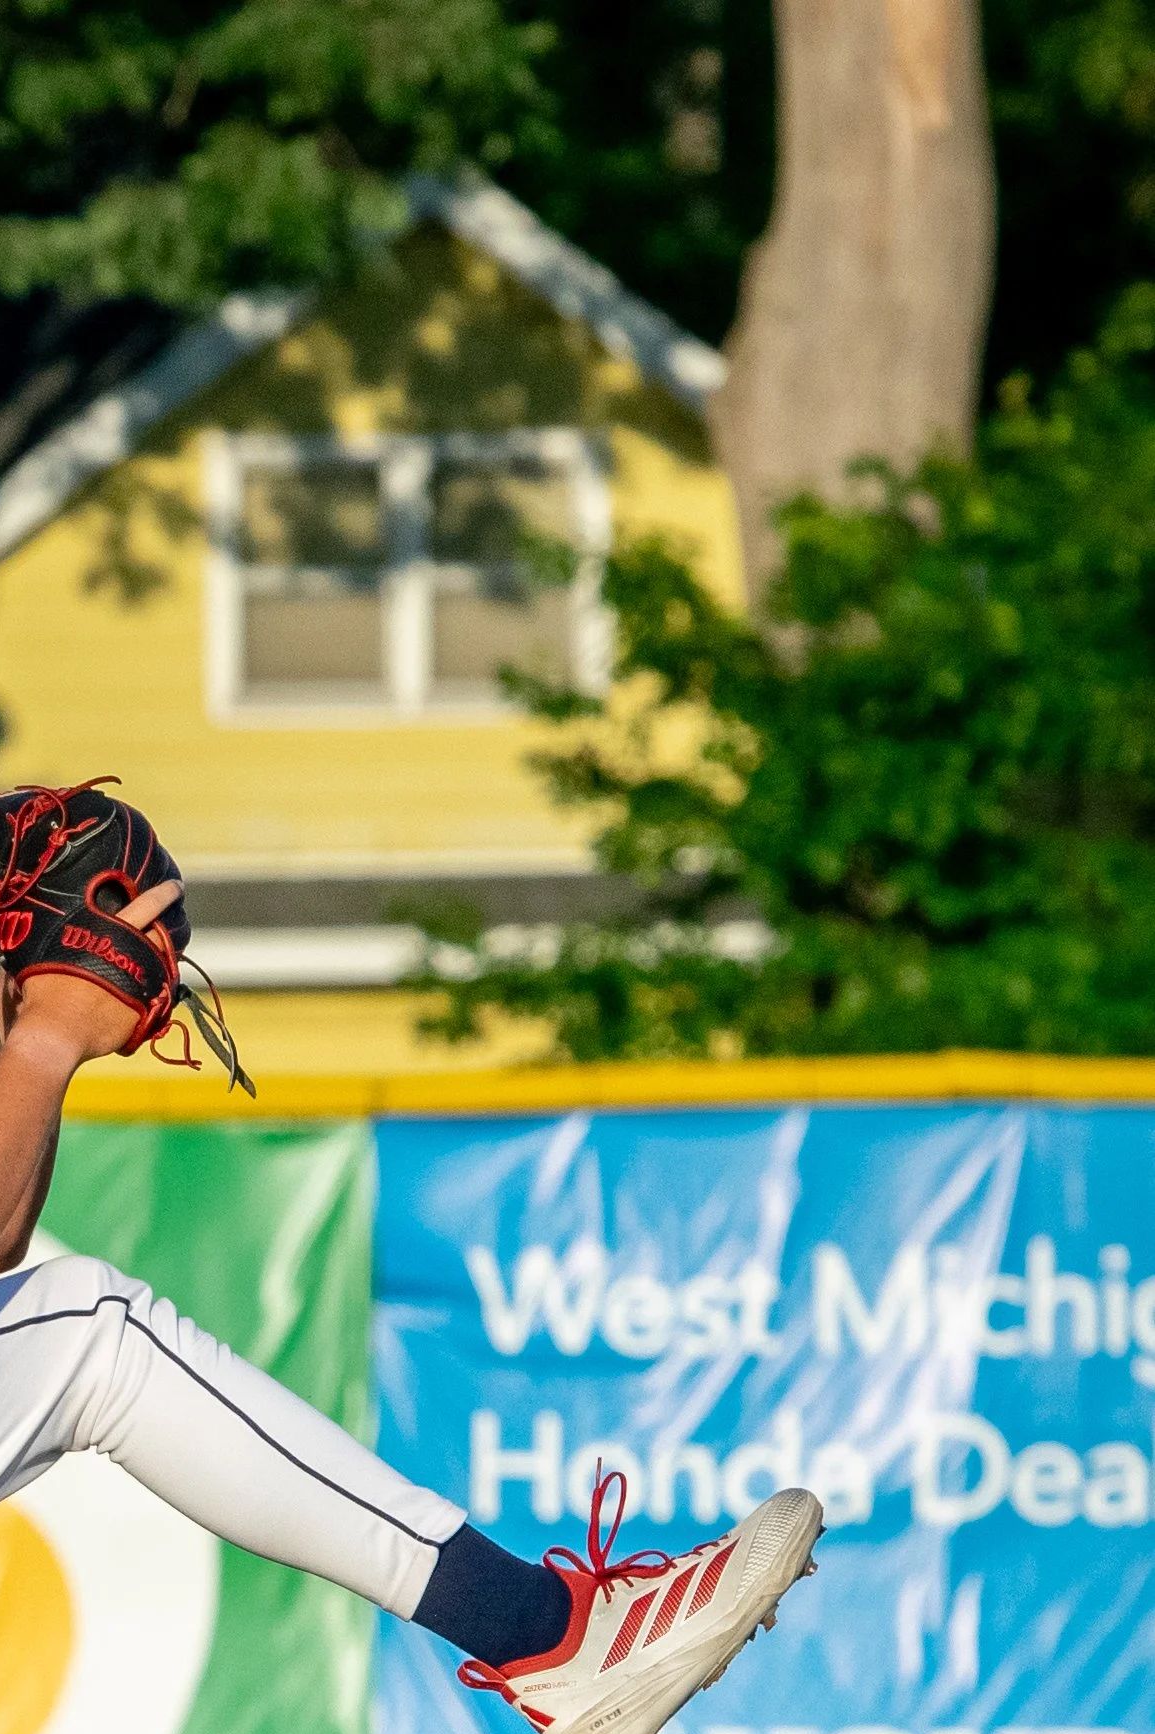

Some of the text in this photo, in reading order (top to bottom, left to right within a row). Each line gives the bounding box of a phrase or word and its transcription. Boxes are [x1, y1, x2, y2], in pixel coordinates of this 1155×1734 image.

[61, 924, 144, 984] Wilson
[465, 1243, 782, 1358] West
[470, 1408, 1155, 1530] Honda Dea
